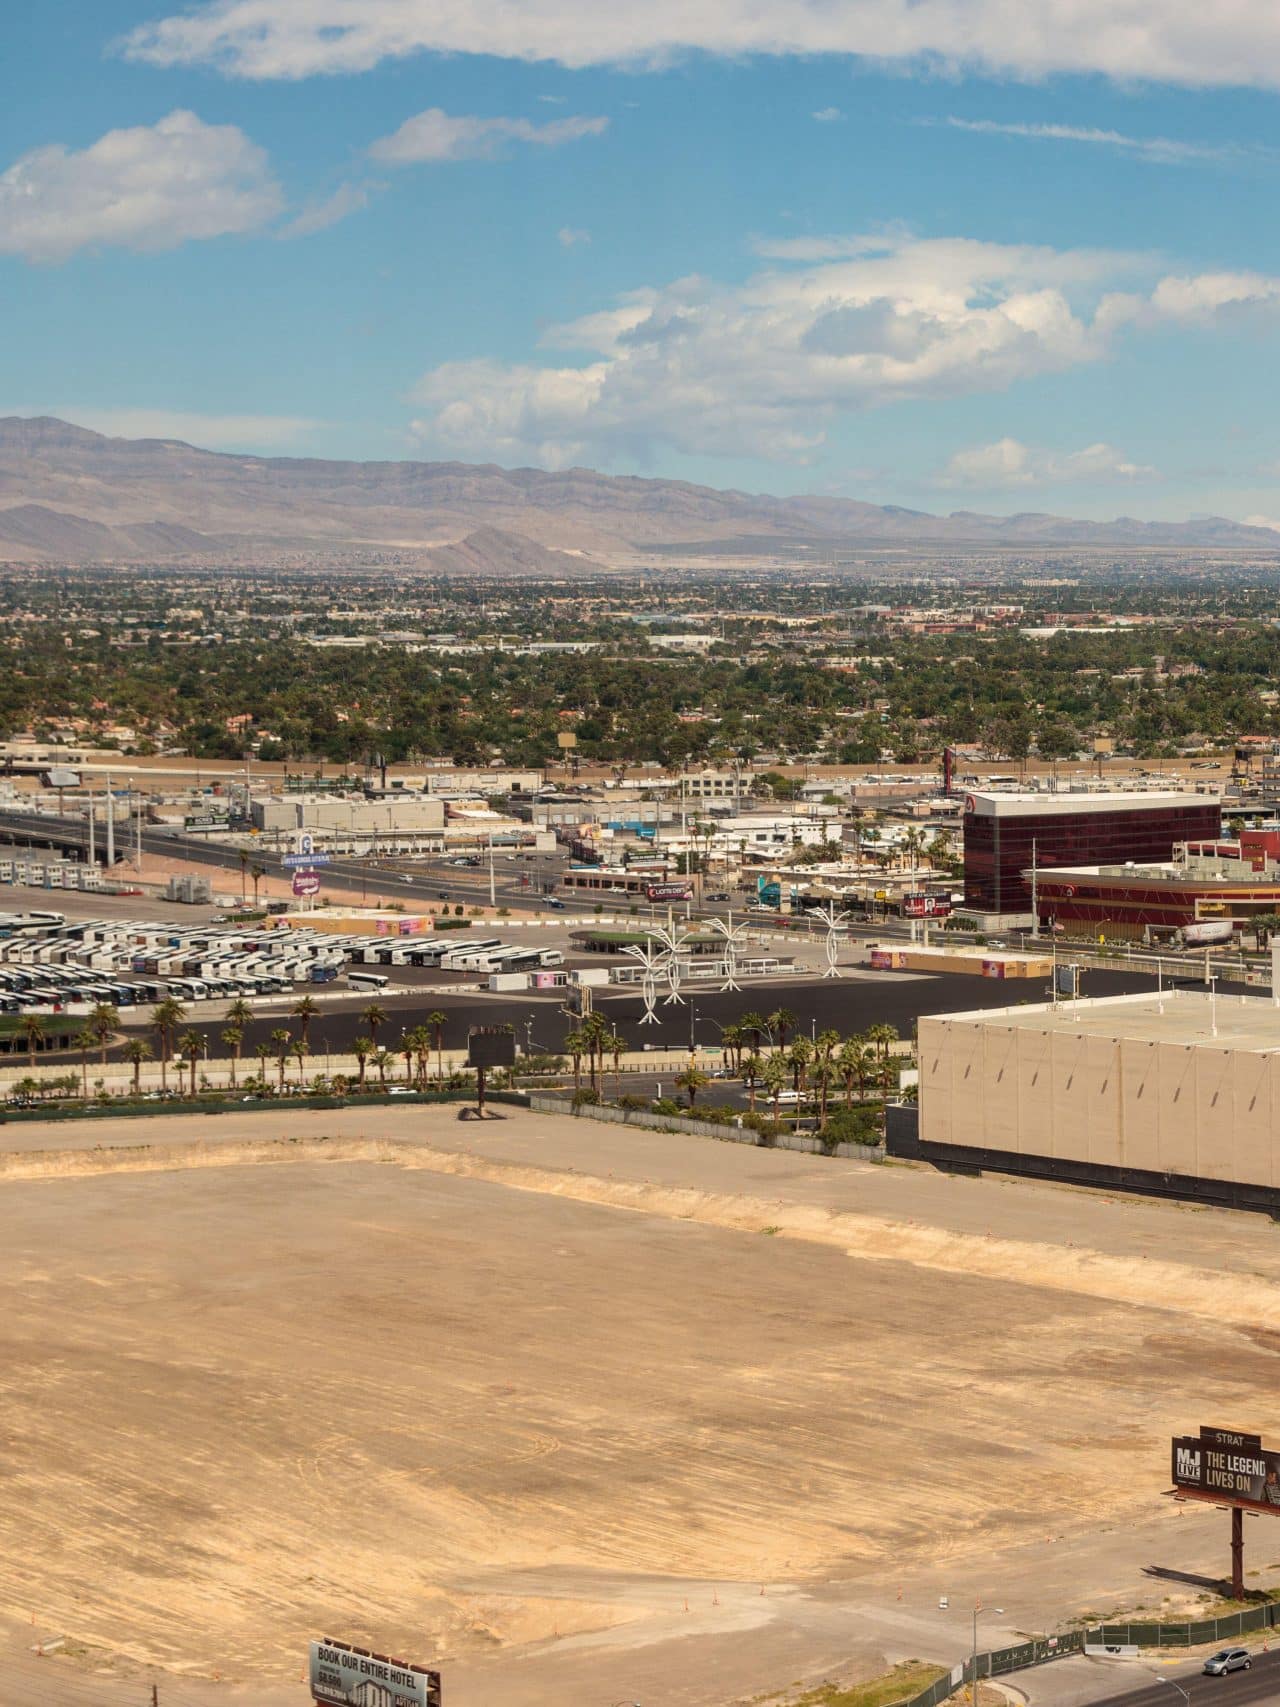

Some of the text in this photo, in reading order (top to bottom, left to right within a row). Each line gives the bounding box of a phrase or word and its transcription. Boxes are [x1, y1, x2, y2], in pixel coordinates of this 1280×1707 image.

[1215, 1433, 1244, 1447] STRAT
[1177, 1448, 1200, 1466] MJ
[1206, 1451, 1266, 1477] THE LEGEND
[1178, 1464, 1200, 1476] LIVE
[1206, 1469, 1251, 1492] LIVES ON
[318, 1646, 341, 1666] BOOK
[341, 1654, 359, 1671] OUR
[360, 1660, 389, 1681] ENTIRE
[390, 1669, 416, 1689] HOTEL
